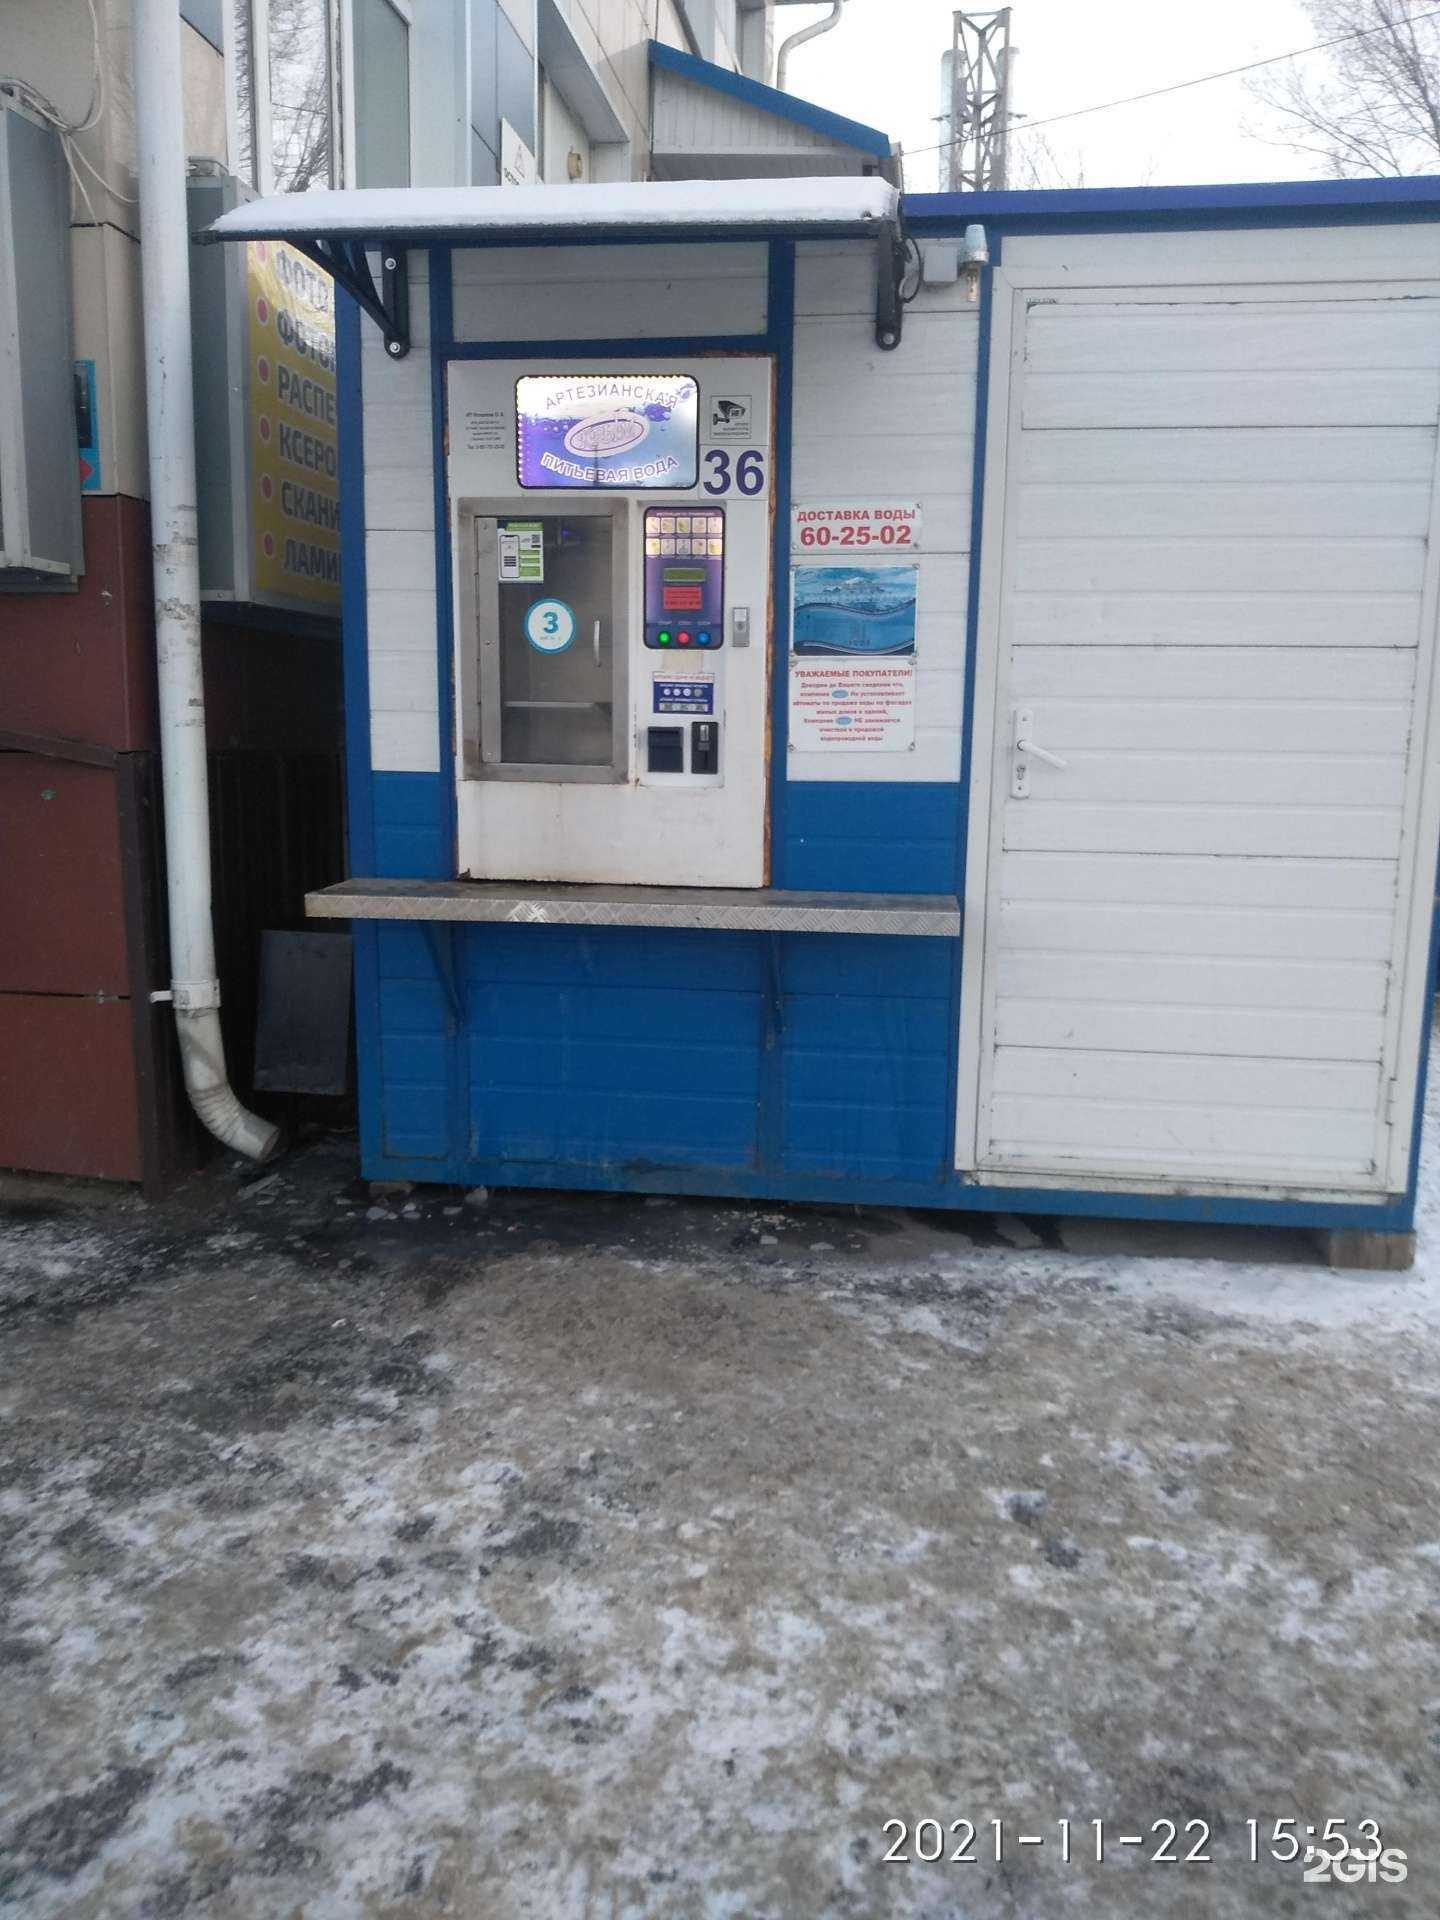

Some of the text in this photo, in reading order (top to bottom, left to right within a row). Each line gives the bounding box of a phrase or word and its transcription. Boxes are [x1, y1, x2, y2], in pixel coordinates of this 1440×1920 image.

[545, 383, 679, 411] АРТЕЗИАНСКАЯ
[541, 452, 678, 482] ПИТЬЕВАЯ ВОДА
[703, 449, 765, 496] 36
[797, 509, 916, 523] ДОСТАВКА ВОДЫ
[800, 525, 912, 546] 60-25-02
[543, 611, 559, 634] 3
[795, 669, 913, 678] УВАЖАЕМЫЕ ПОКУПАТЕЛИ!
